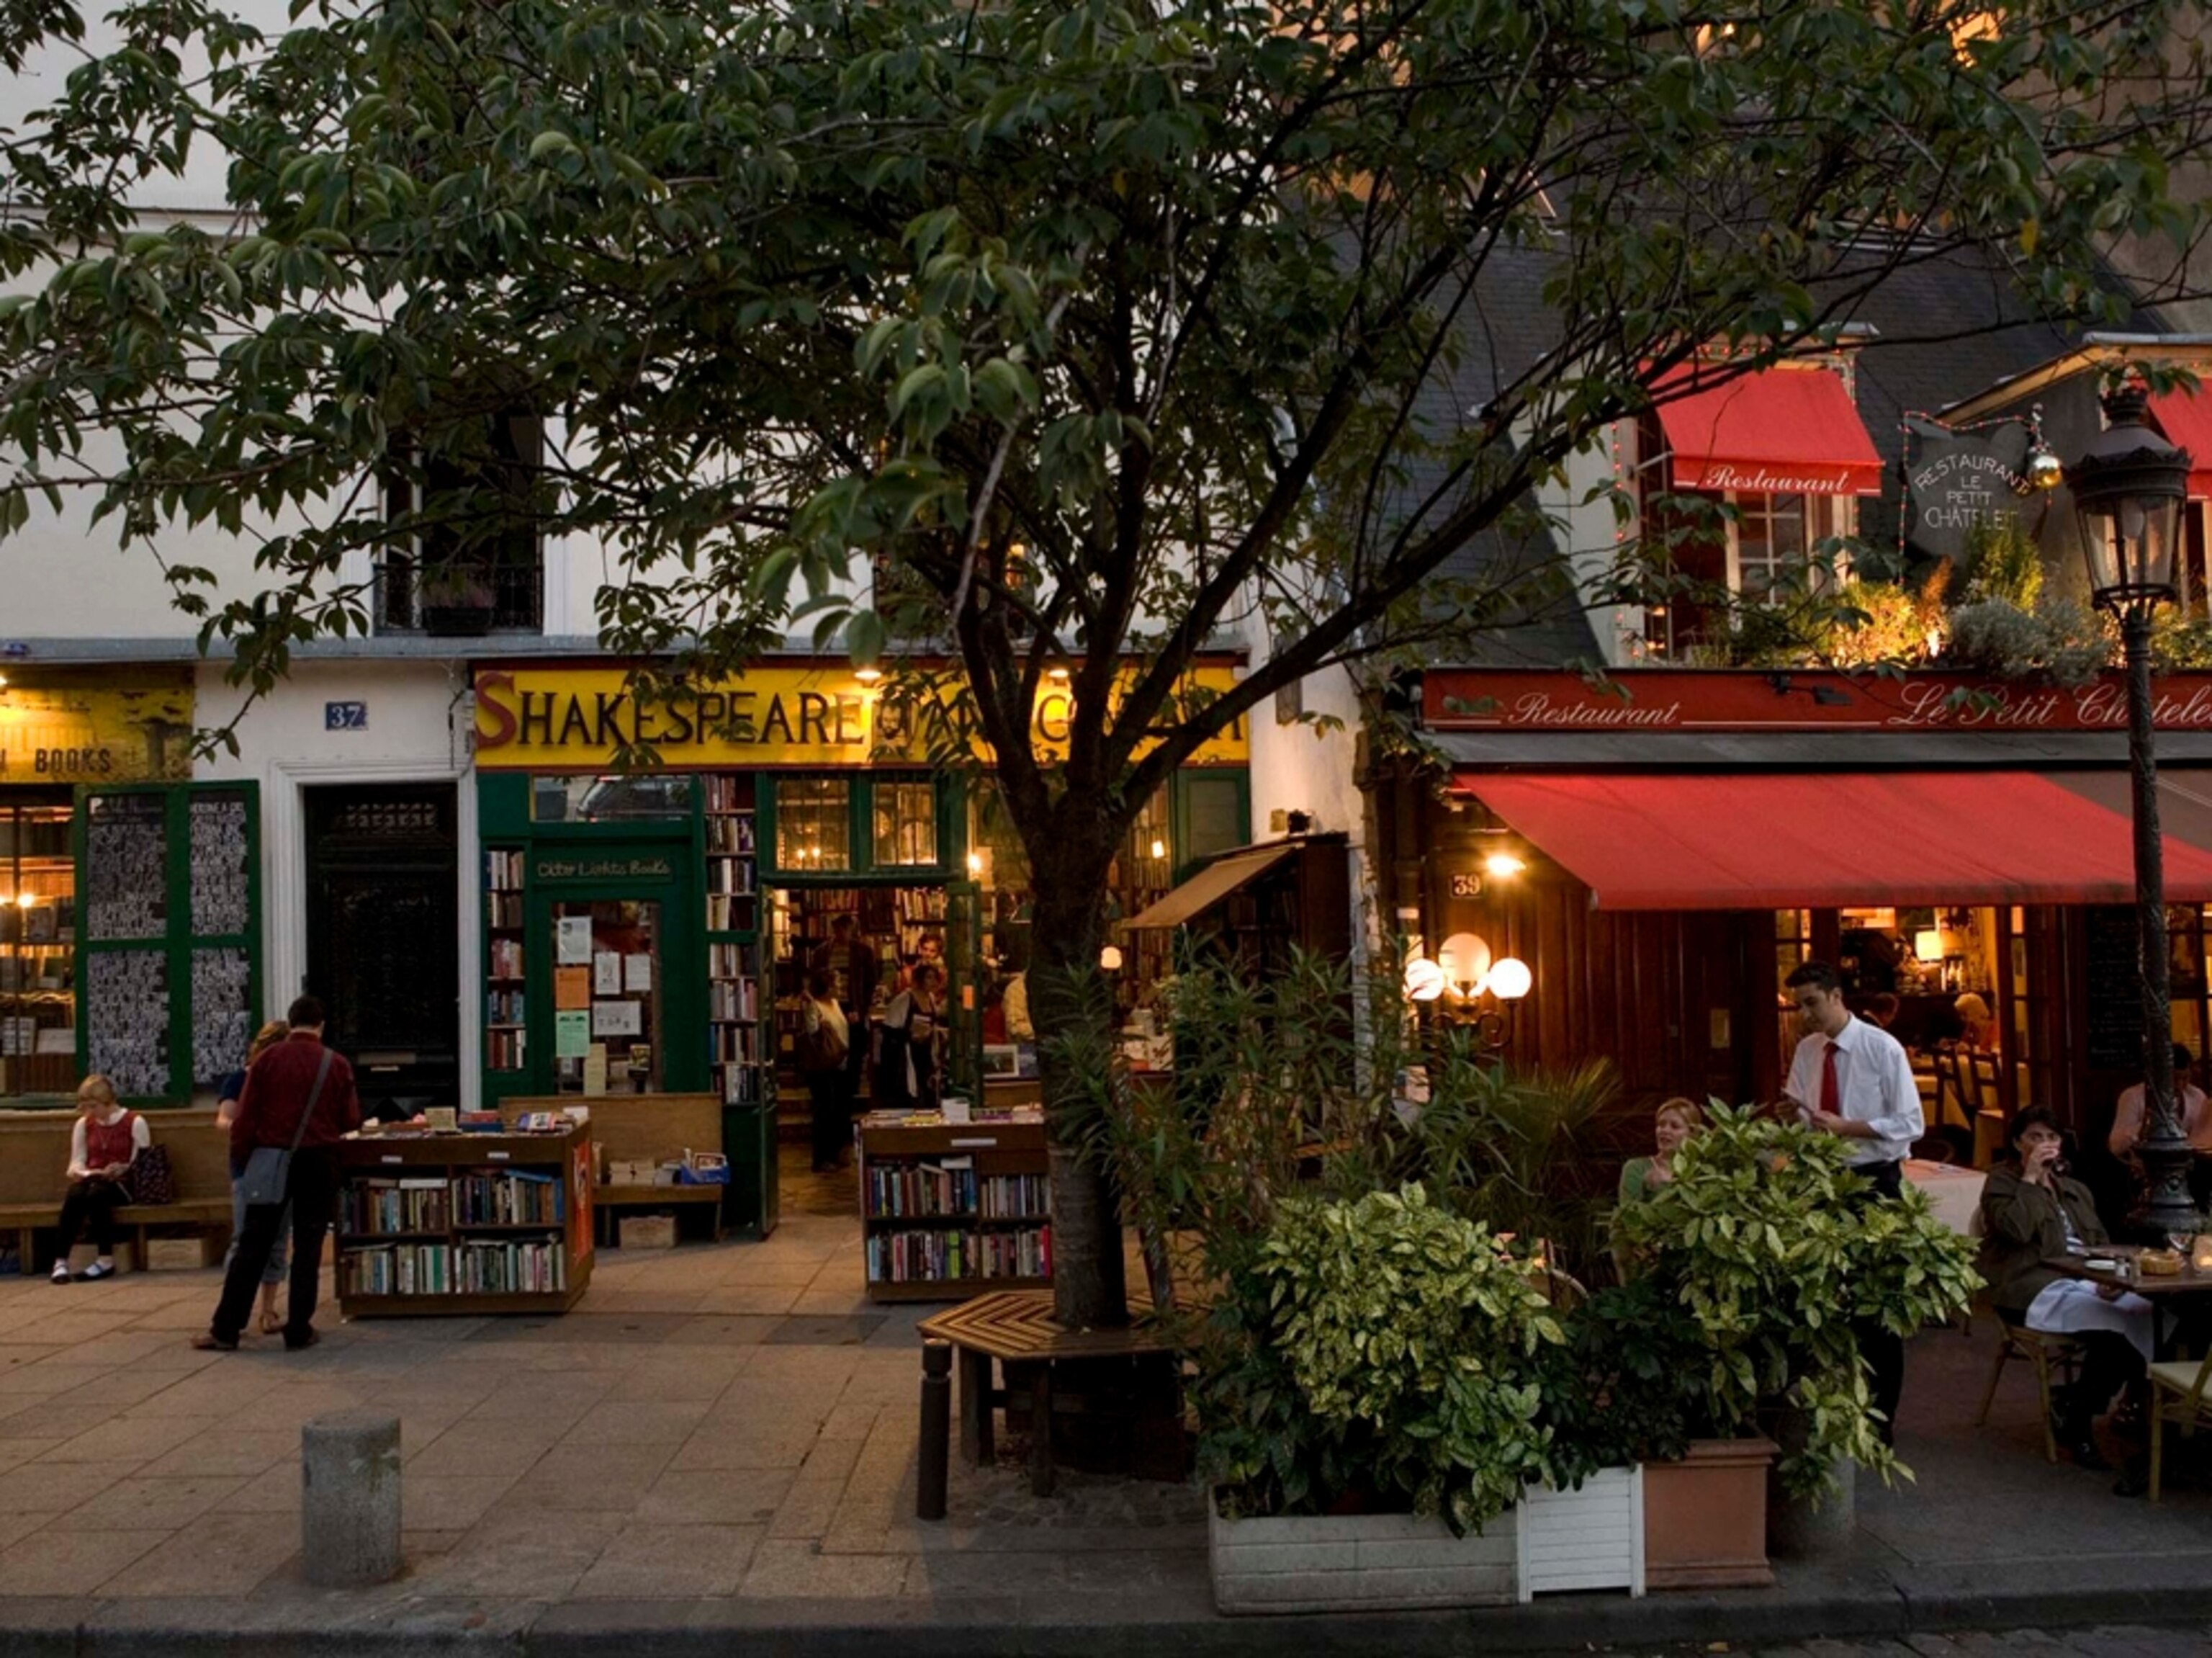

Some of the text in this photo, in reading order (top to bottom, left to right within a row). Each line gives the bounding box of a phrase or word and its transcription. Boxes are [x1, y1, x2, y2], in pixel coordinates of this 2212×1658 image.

[1706, 465, 1849, 491] Restaurant
[1915, 454, 2031, 495] RESTAURANT
[1961, 475, 1981, 490] LE
[1946, 491, 1992, 506] PETIT
[475, 671, 863, 750] SHAKESPEARE
[1508, 692, 1680, 725] Restaurant
[1887, 681, 2212, 725] Le Petit Chtele
[332, 706, 360, 727] 37
[35, 748, 111, 774] BOOKS
[1454, 874, 1480, 895] 39
